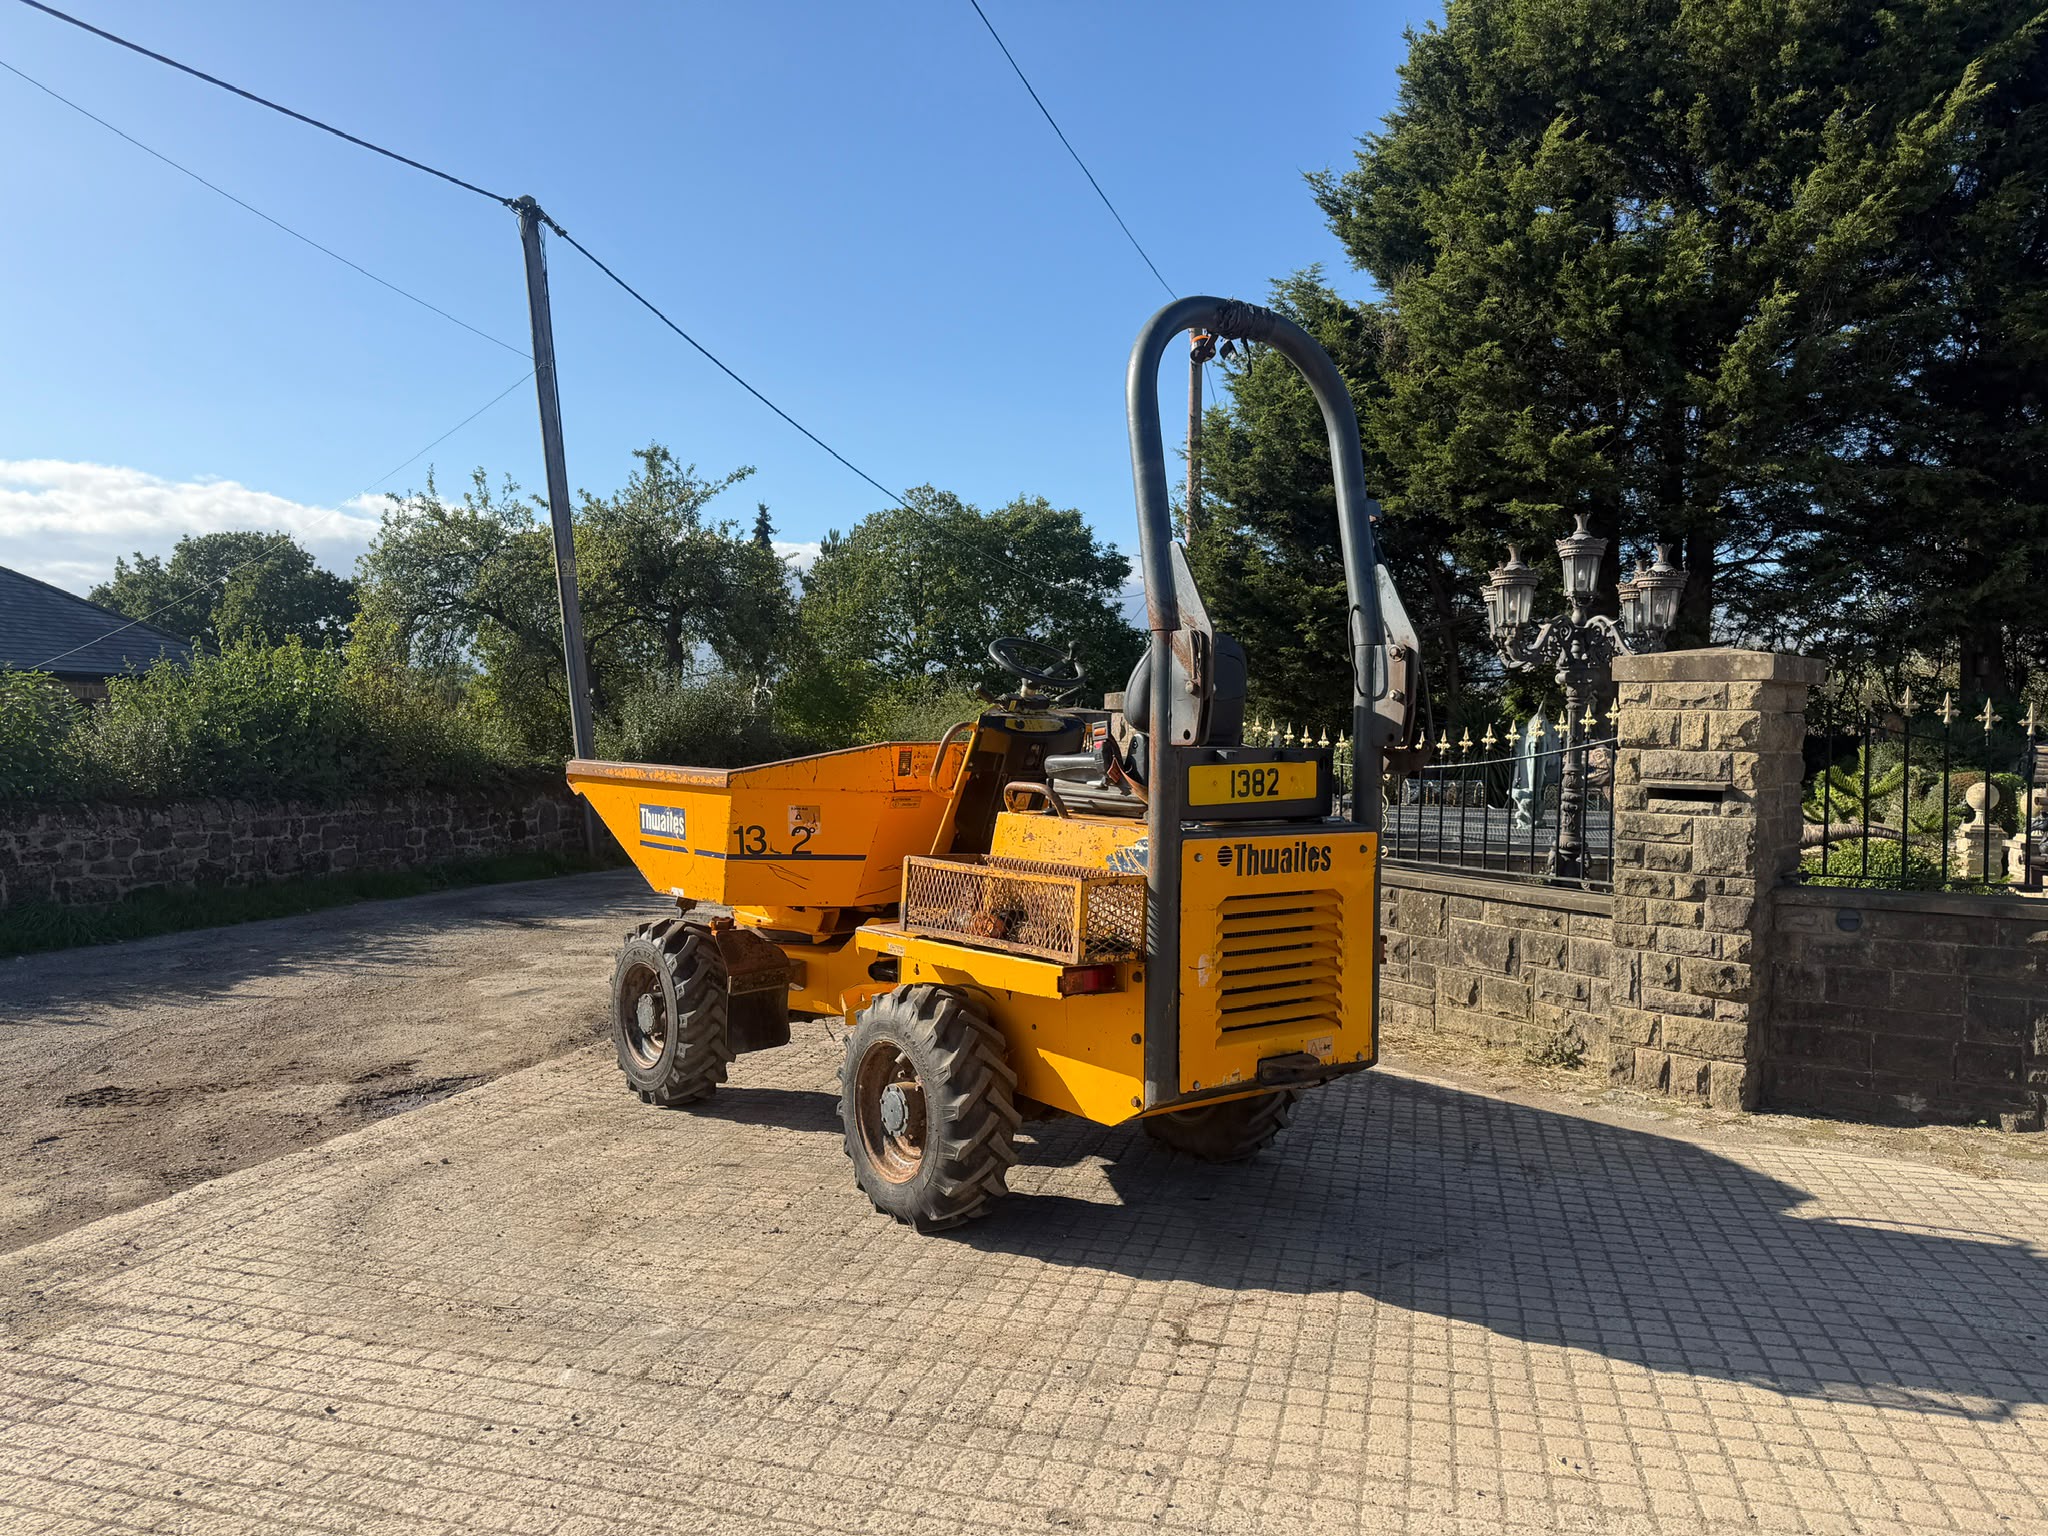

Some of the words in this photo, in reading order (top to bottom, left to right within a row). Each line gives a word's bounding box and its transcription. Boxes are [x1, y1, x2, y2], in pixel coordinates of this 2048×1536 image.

[1231, 768, 1279, 798] 1382
[640, 807, 685, 835] Thwaites
[733, 825, 812, 855] 132
[1234, 841, 1332, 876] Thwaites
